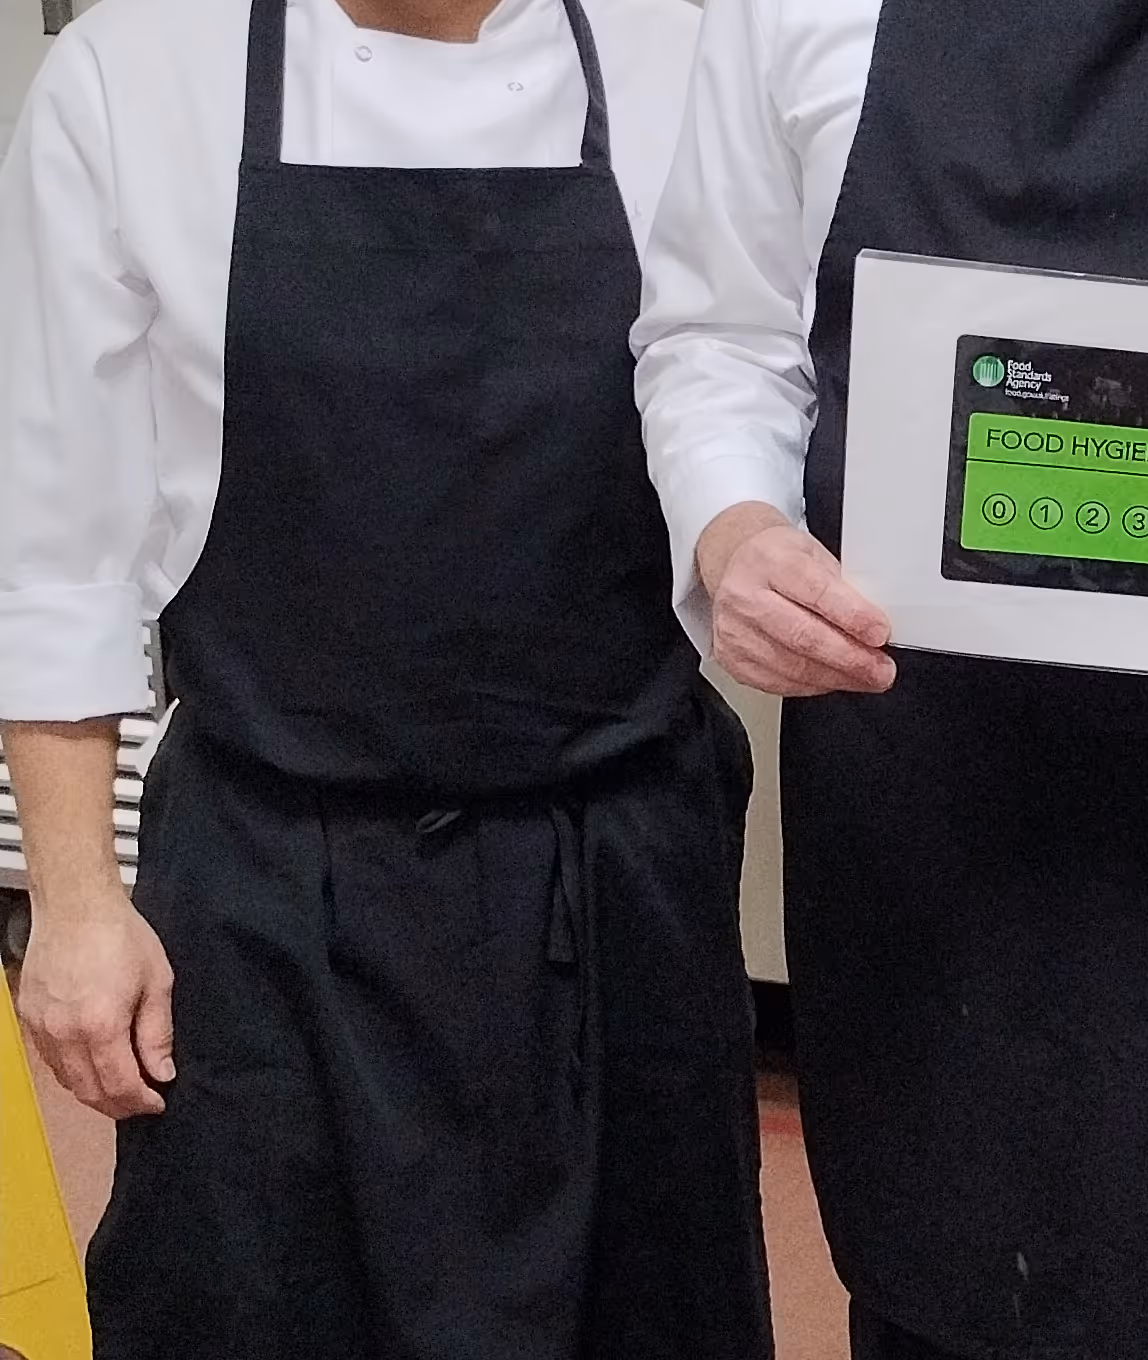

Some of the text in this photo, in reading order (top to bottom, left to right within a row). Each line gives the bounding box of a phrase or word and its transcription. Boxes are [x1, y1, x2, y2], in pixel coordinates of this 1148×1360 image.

[1007, 359, 1032, 372] Food
[1006, 369, 1052, 383] Standards
[1005, 379, 1042, 392] Agency
[986, 428, 1064, 453] FOOD
[992, 500, 1006, 519] 0
[1039, 504, 1050, 523] 1
[1085, 507, 1100, 527] 2
[1132, 512, 1146, 531] 3
